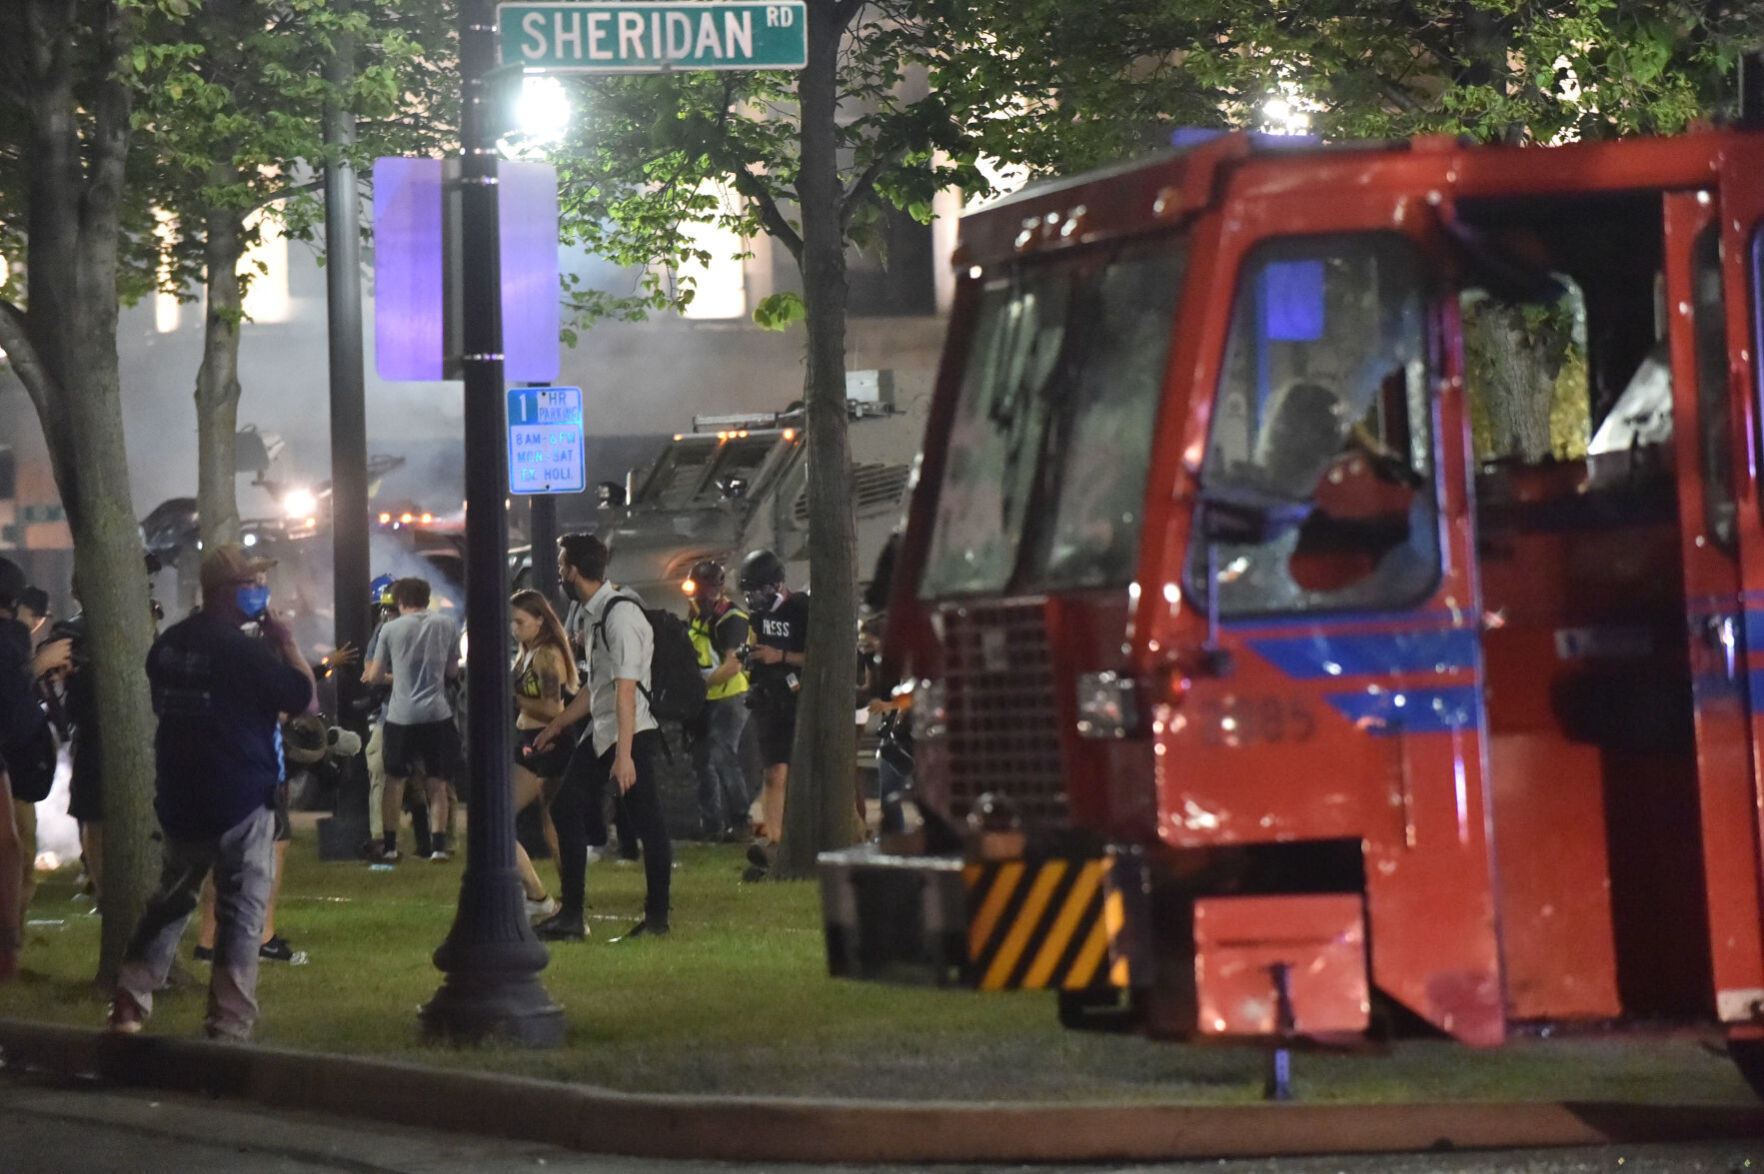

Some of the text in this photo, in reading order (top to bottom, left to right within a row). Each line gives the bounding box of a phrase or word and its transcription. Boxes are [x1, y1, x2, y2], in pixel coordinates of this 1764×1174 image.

[521, 6, 793, 60] SHERIDAN RD
[519, 392, 567, 422] 1 HR
